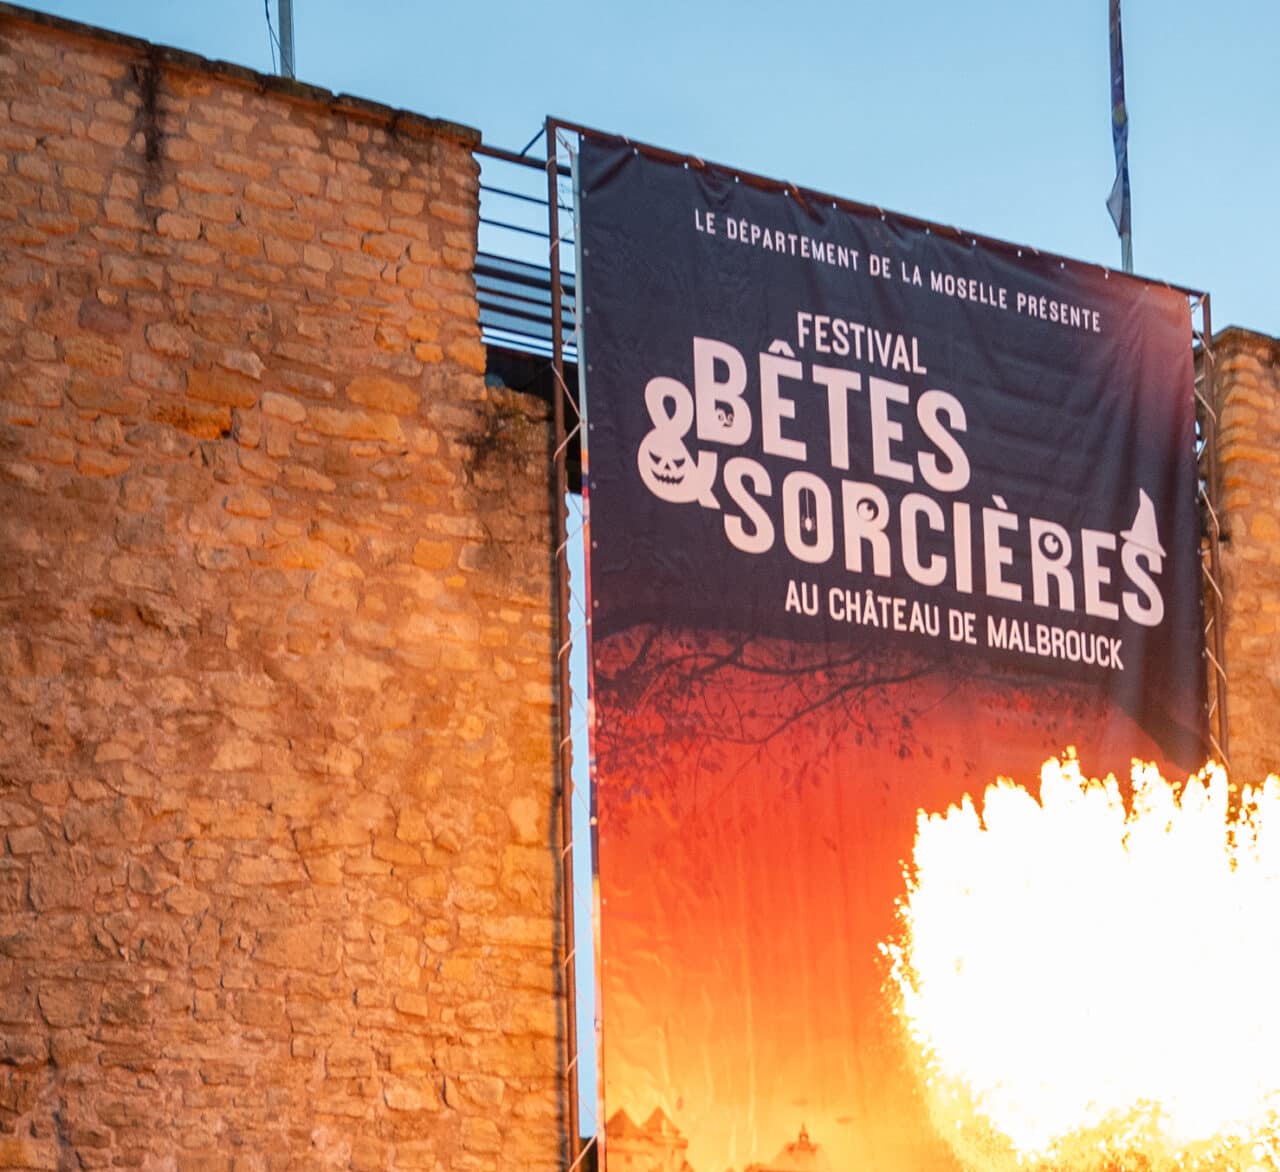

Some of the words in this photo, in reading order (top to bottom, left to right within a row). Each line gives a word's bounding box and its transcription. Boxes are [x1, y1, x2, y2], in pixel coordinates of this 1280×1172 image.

[695, 208, 716, 235] LE
[726, 217, 859, 272] DÉPARTEMENT
[869, 253, 892, 279] DE
[901, 261, 923, 288] LA
[930, 269, 1008, 310] MOSELLE
[1017, 290, 1101, 333] PRÉSENTE
[796, 310, 927, 376] FESTIVAL
[692, 335, 973, 493] BÊTES
[637, 376, 721, 511] &
[722, 455, 1166, 628] SORCIÈRES
[784, 579, 819, 617] AU
[828, 586, 941, 638] CHÂTEAU
[949, 608, 978, 646] DE
[987, 614, 1125, 672] MALBROUCK
